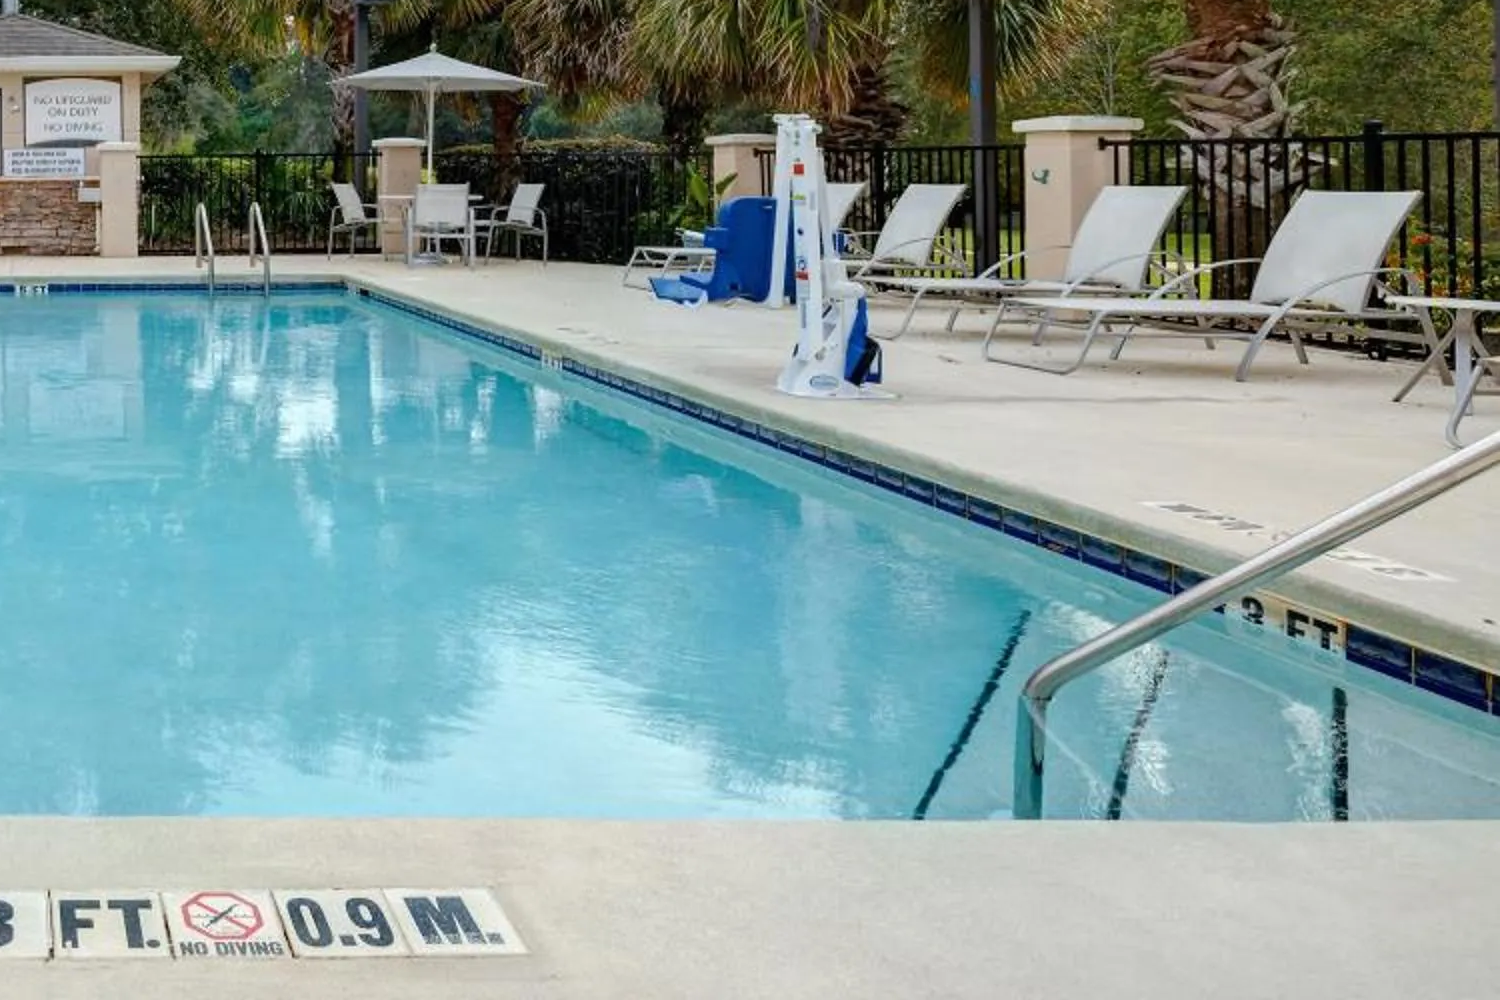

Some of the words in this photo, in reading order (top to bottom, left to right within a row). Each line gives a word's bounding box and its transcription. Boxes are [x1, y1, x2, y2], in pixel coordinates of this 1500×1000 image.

[34, 96, 53, 105] NO
[47, 107, 67, 117] ON
[69, 107, 99, 117] DUTY
[58, 899, 160, 949] FT.
[287, 896, 394, 948] 0.9
[403, 895, 506, 945] M.
[179, 942, 208, 956] NO
[215, 941, 284, 957] DIVING
